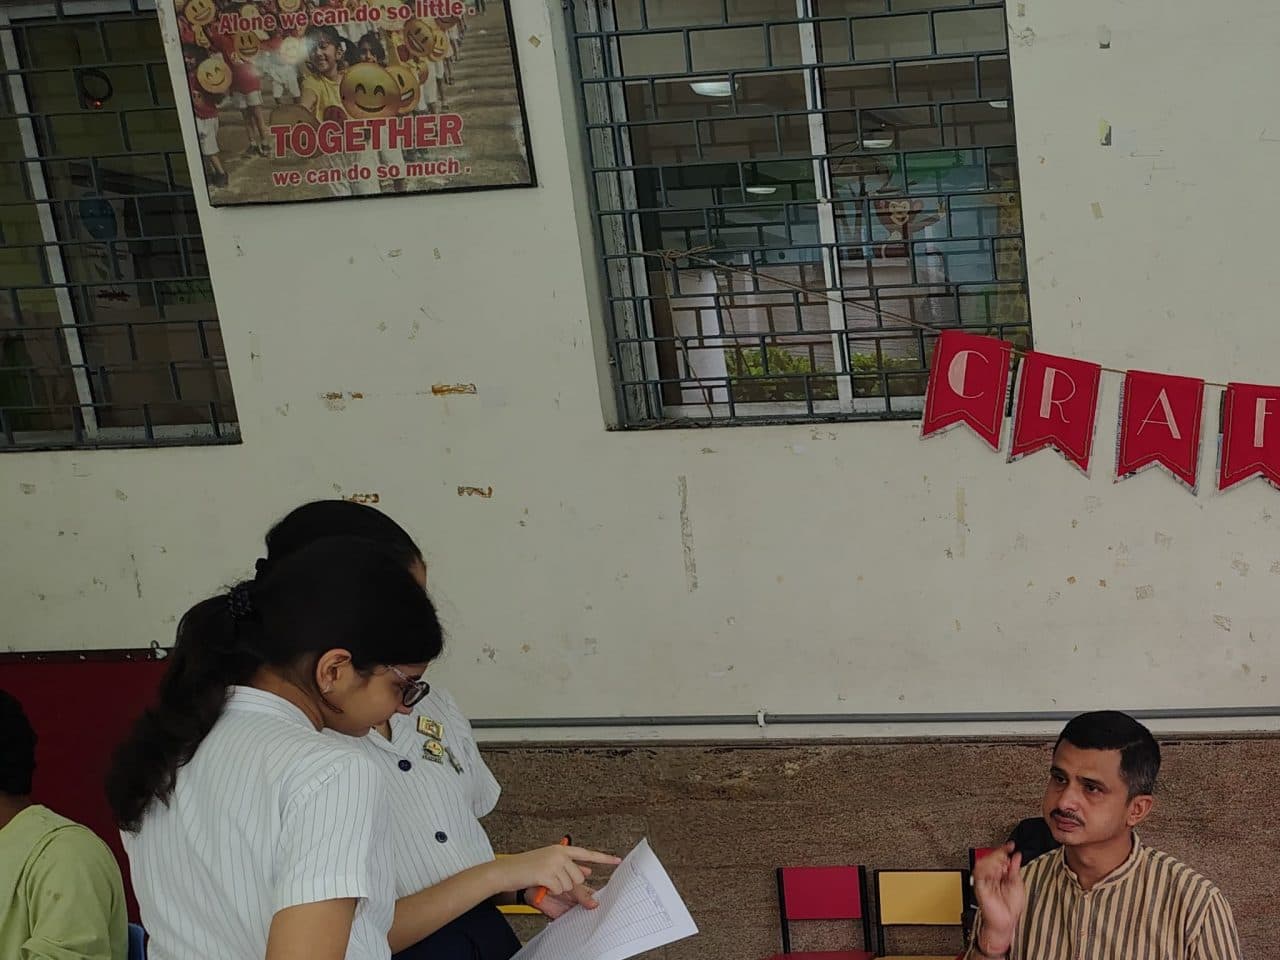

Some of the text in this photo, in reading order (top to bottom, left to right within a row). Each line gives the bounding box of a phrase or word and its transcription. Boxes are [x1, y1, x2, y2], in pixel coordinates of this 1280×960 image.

[220, 14, 275, 33] Alone
[280, 14, 307, 29] we
[313, 8, 349, 25] can
[355, 4, 381, 22] do
[387, 4, 411, 20] so
[271, 114, 463, 158] TOGETHER
[273, 171, 300, 186] we
[306, 168, 341, 184] can
[347, 162, 371, 180] do
[377, 163, 400, 178] so
[405, 157, 459, 177] much
